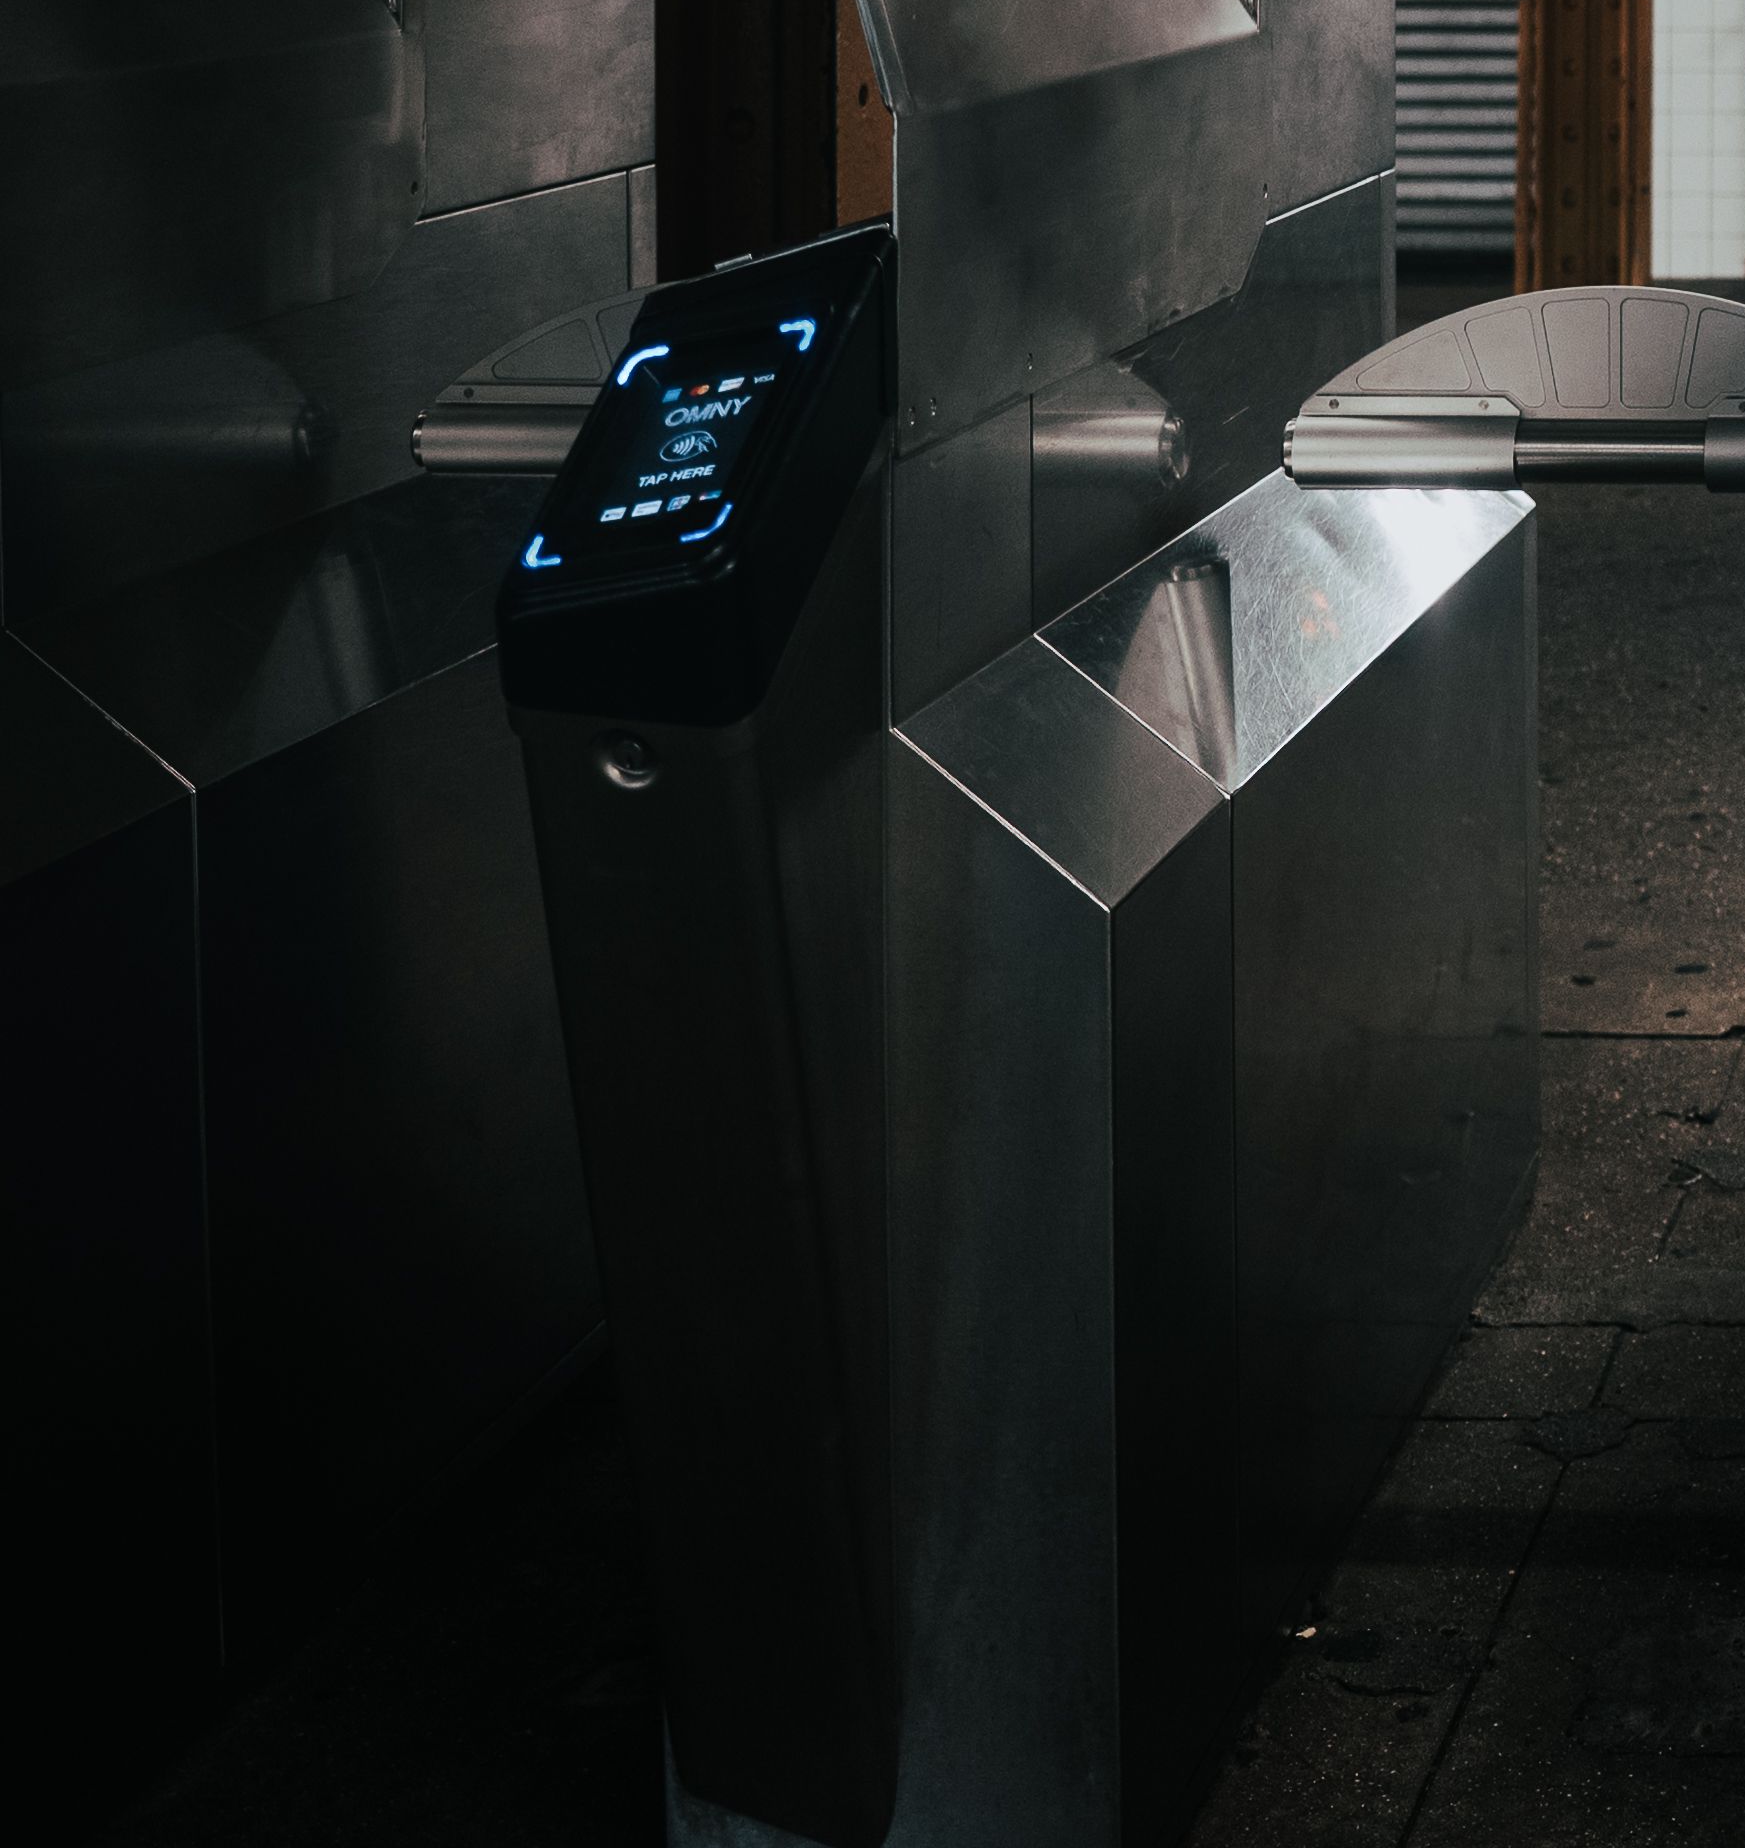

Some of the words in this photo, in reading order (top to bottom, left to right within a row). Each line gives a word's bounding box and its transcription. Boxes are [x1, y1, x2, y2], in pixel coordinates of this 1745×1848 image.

[664, 395, 753, 428] OMNY
[638, 470, 667, 489] TAP
[670, 463, 715, 483] HERE
